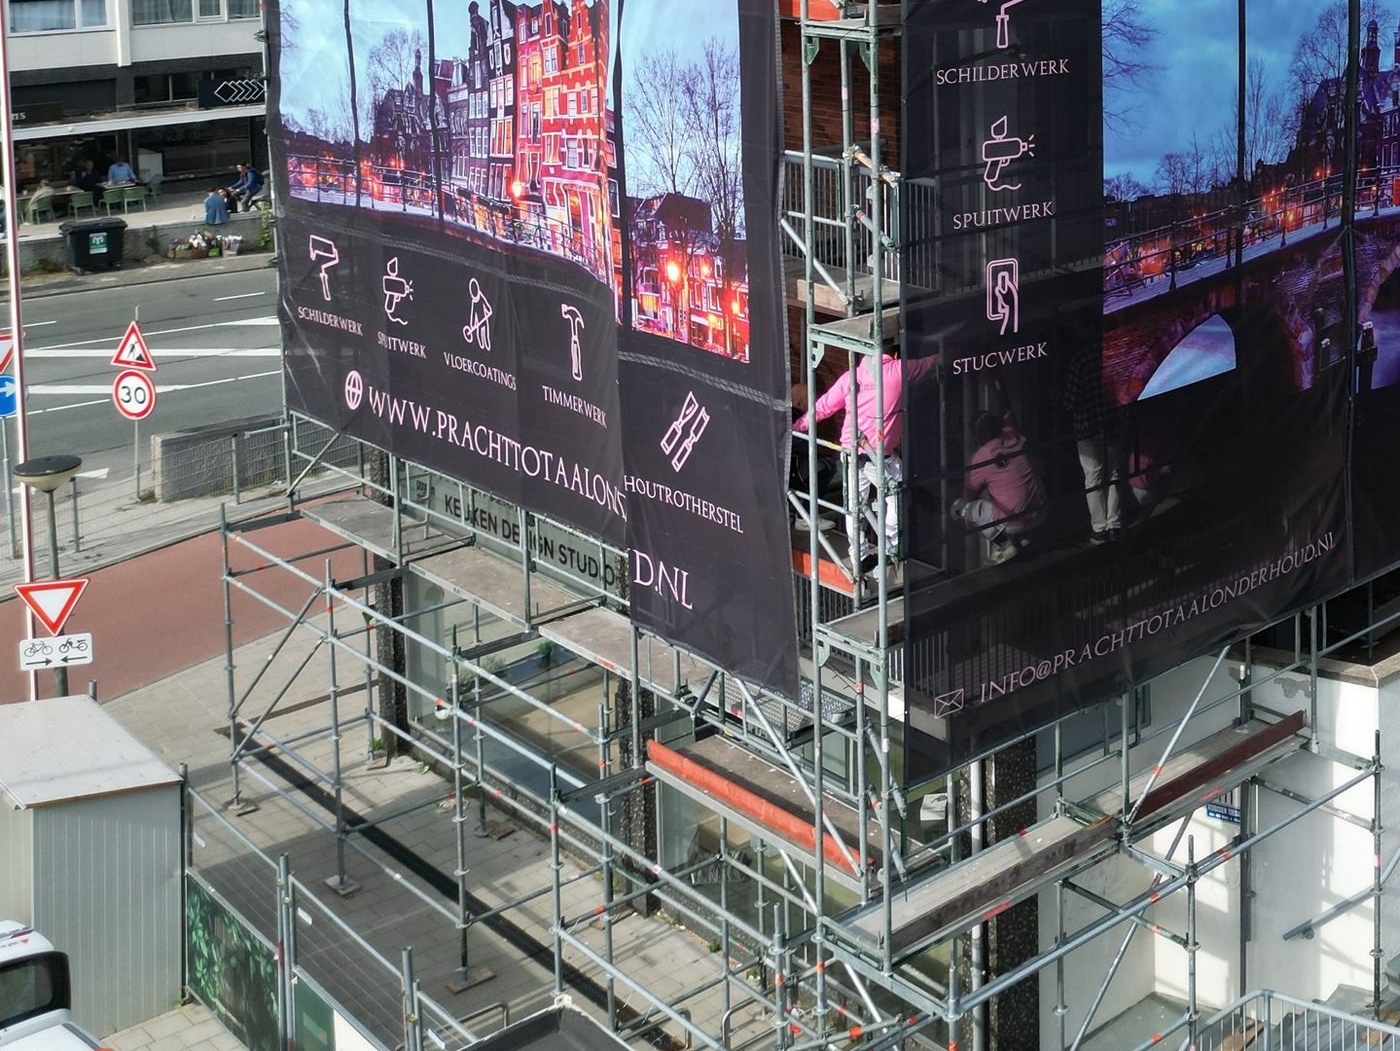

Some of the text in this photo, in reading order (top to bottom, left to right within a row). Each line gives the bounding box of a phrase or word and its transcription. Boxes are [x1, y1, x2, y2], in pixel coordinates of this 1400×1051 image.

[936, 59, 1070, 86] SCHILDERWERK
[953, 201, 1056, 231] SPUITWERK
[298, 306, 363, 337] SCHILDERWERK
[443, 351, 517, 391] VLOERCOATINGS
[953, 342, 1049, 376] STUCWERK
[120, 385, 147, 405] 30
[542, 385, 608, 429] TIMMERWERK
[624, 475, 743, 534] HOUTROTHERSTEL
[502, 518, 555, 559] DEIGN
[559, 543, 616, 586] STUDO
[980, 531, 1336, 704] INFO@PRACHTTOTAALONDERHOUD.NL
